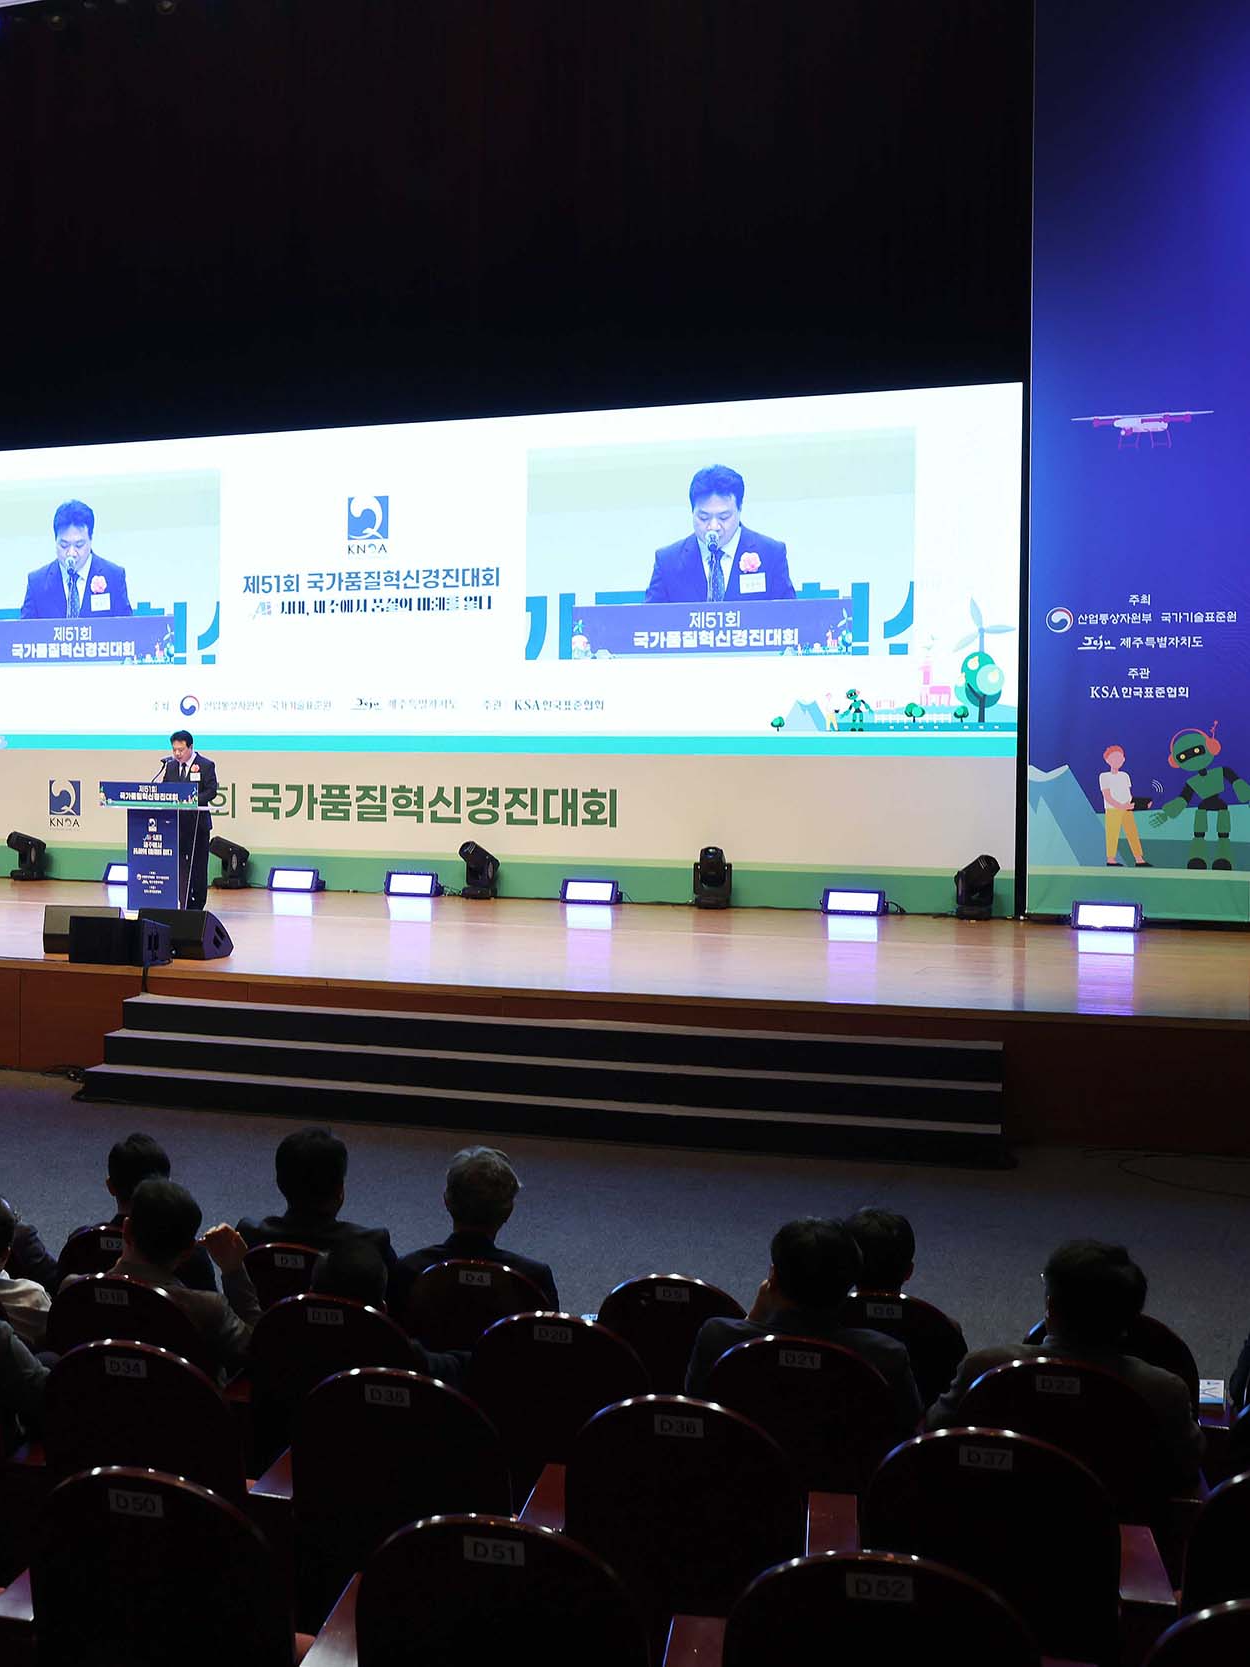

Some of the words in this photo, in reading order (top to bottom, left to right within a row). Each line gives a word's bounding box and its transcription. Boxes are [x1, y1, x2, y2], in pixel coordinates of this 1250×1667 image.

[243, 573, 300, 594] 제51회
[307, 567, 500, 592] 국가품질혁신경진대회
[1128, 594, 1151, 606] 주최
[689, 610, 741, 629] 제51회
[1077, 612, 1152, 625] 산업통상자원부
[1160, 611, 1237, 624] 국가기술표준원
[53, 625, 92, 642] 제51회
[632, 628, 799, 649] 국가품질혁신경진대회
[1077, 635, 1116, 650] Jeju
[1120, 636, 1203, 648] 제주특별자치도
[11, 641, 135, 659] 국가품질혁신경진대회
[1127, 668, 1150, 679] 주관
[249, 783, 618, 828] 국가품질혁신경진대회
[464, 1272, 485, 1283] D4
[965, 1450, 1007, 1467] D37
[116, 1494, 156, 1513] D50
[472, 1541, 517, 1563] D51
[854, 1577, 906, 1597] D52
